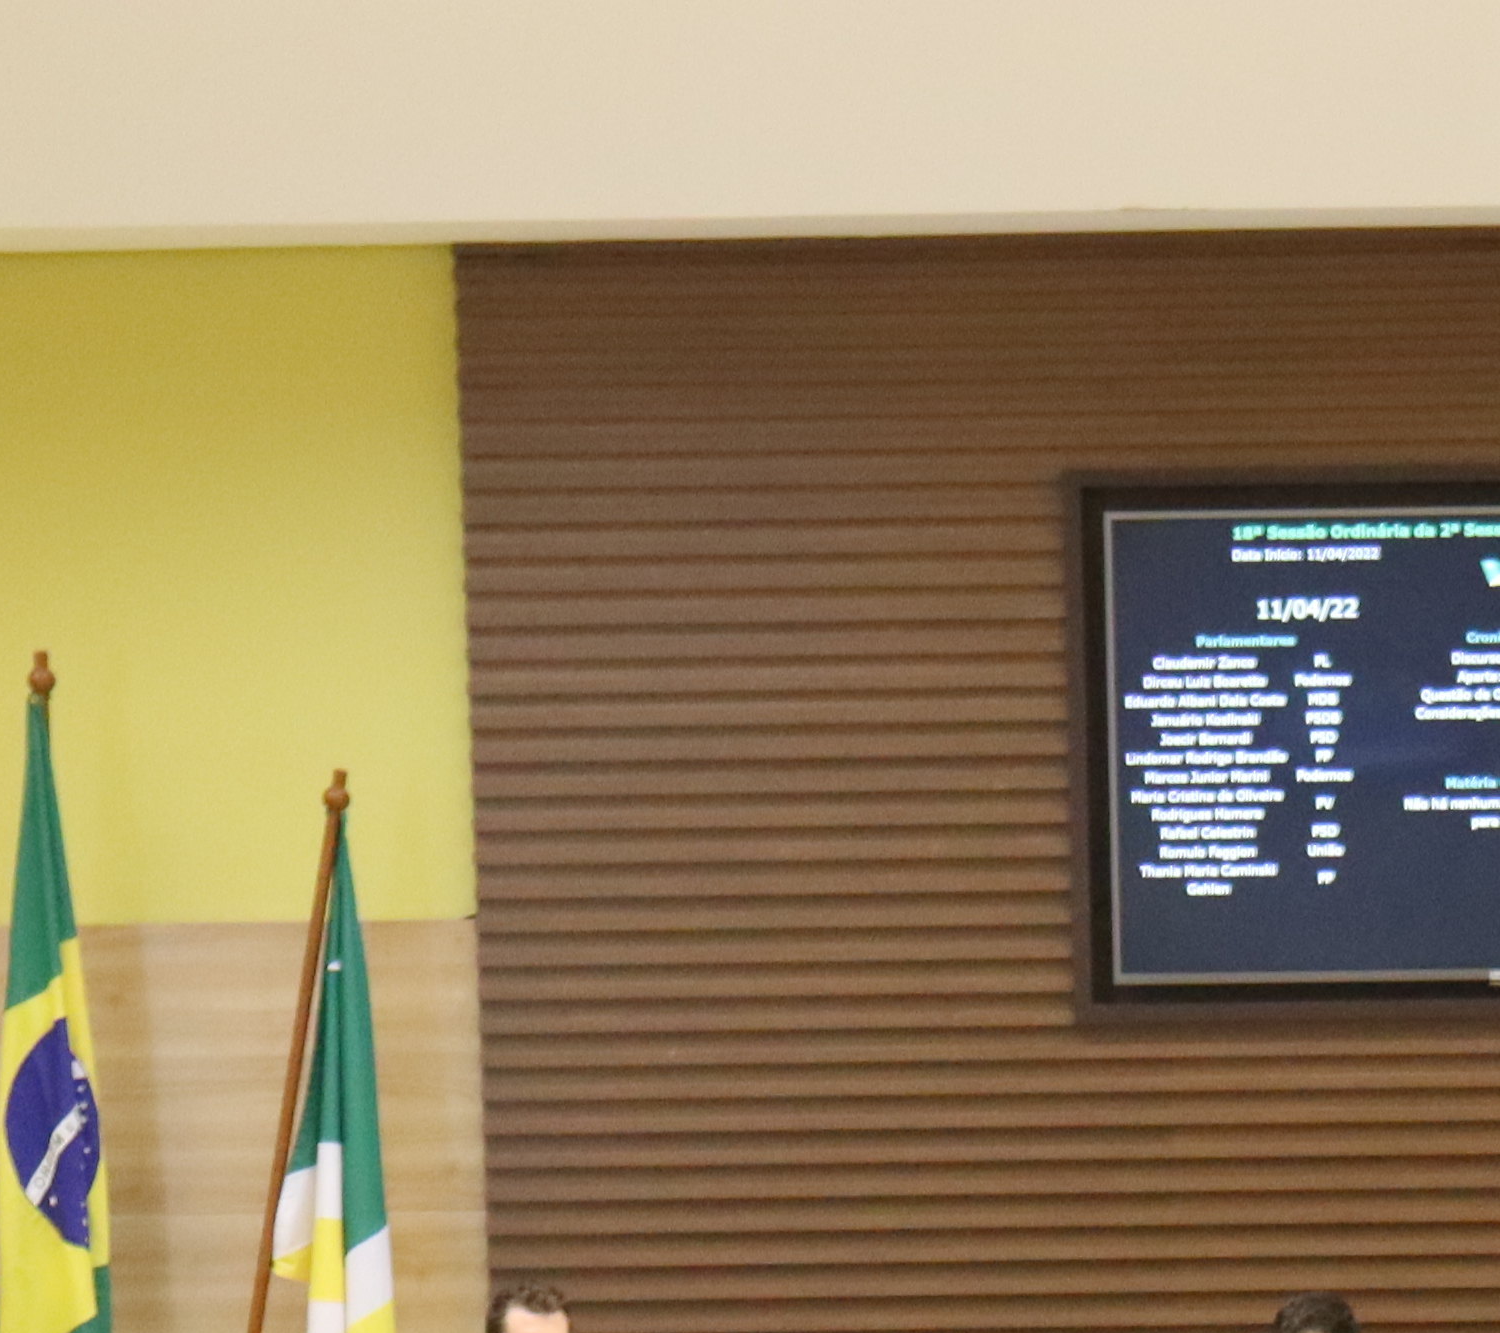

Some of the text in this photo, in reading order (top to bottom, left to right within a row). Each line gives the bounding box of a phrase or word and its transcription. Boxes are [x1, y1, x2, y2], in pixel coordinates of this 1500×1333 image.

[1232, 525, 1264, 541] 18ª
[1266, 523, 1327, 539] Sessão
[1330, 523, 1410, 539] Ordinária
[1413, 523, 1436, 539] da
[1439, 523, 1461, 538] 2ª
[1232, 547, 1263, 562] Data
[1306, 545, 1381, 561] 11/04/2022
[1256, 597, 1360, 622] 11/04/22
[1195, 634, 1298, 647] Parlamentares
[1152, 655, 1258, 670] Claudemir Zanco
[1313, 653, 1332, 668] PL
[1143, 675, 1269, 689] Dirceu Luiz Boaretto
[1294, 673, 1352, 687] Podemos
[1124, 695, 1177, 709] Eduardo
[1218, 694, 1249, 707] Dala
[1250, 693, 1288, 707] Costa
[1307, 691, 1340, 706] MDB
[1420, 686, 1473, 704] Questão
[1474, 687, 1491, 701] de
[1150, 712, 1204, 728] Januário
[1305, 709, 1343, 725] PSDB
[1159, 731, 1253, 746] Joecir Bernardi
[1309, 729, 1339, 744] PSD
[1125, 749, 1289, 766] Lindomar Rodrigo Brandão
[1315, 748, 1334, 763] PP
[1144, 769, 1270, 784] Marcos Junior Marini
[1296, 768, 1354, 782] Podemos
[1445, 776, 1499, 790] Matéria
[1131, 789, 1285, 803] Maria Cristina de Oliveira
[1315, 795, 1335, 810] PV
[1404, 795, 1430, 811] Não
[1431, 797, 1449, 810] há
[1151, 807, 1265, 823] Rodrigues Hamera
[1471, 815, 1500, 830] para
[1160, 826, 1257, 840] Rafael Celestrin
[1311, 823, 1341, 837] PSD
[1159, 844, 1258, 861] Romulo Faggion
[1307, 842, 1346, 857] União
[1139, 862, 1279, 878] Thania Maria Caminski
[1317, 869, 1336, 884] PP
[1186, 882, 1232, 896] Gehlen
